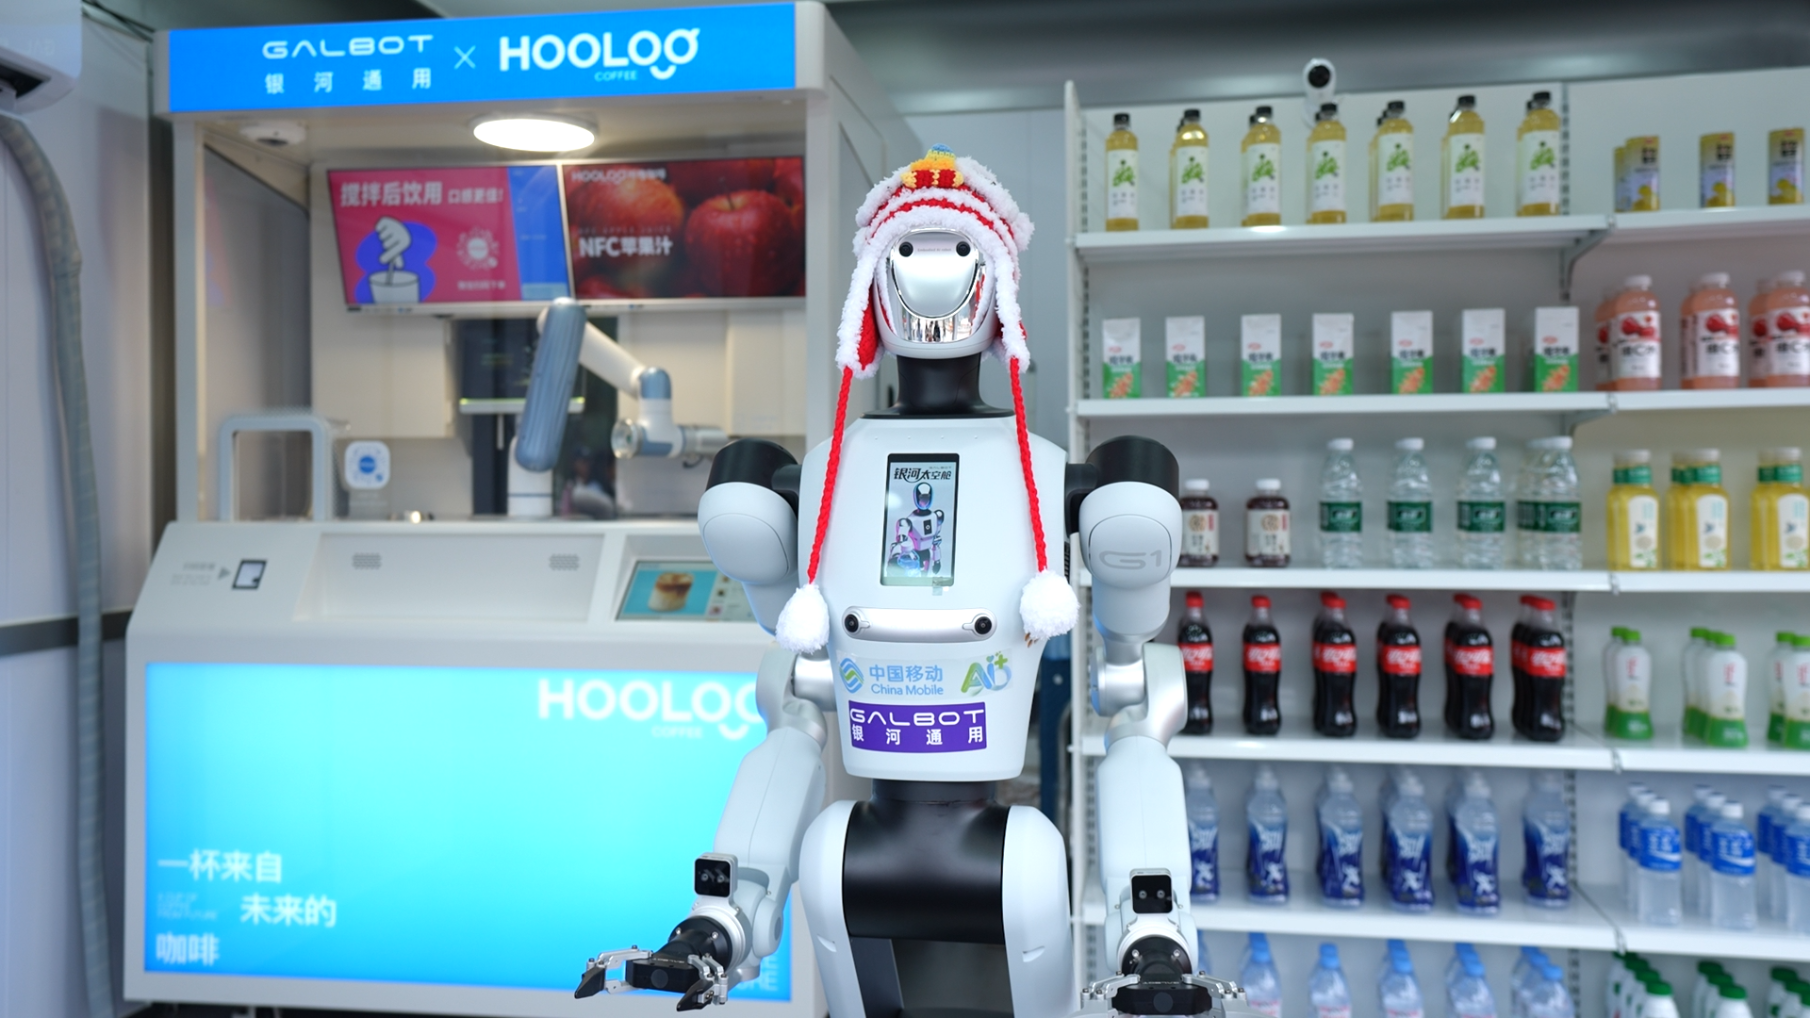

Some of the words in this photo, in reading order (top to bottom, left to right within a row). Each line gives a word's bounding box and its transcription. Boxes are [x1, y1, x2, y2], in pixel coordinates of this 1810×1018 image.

[262, 34, 434, 59] GALBOT
[264, 67, 432, 95] 银河通用
[594, 69, 638, 82] COFFEE
[340, 181, 443, 207] 搅拌后饮用
[578, 235, 673, 258] NFC苹果汁
[894, 467, 952, 483] 银河太空舱
[1099, 550, 1162, 569] G1
[869, 664, 943, 683] 中国移动
[871, 684, 903, 696] China
[905, 684, 944, 696] Mobile
[849, 708, 984, 726] GALBOT
[651, 725, 702, 739] COFFEE
[851, 724, 983, 746] 银河通用
[157, 848, 283, 884] 一杯来自
[240, 892, 337, 928] 未来的
[156, 931, 220, 967] 咖啡
